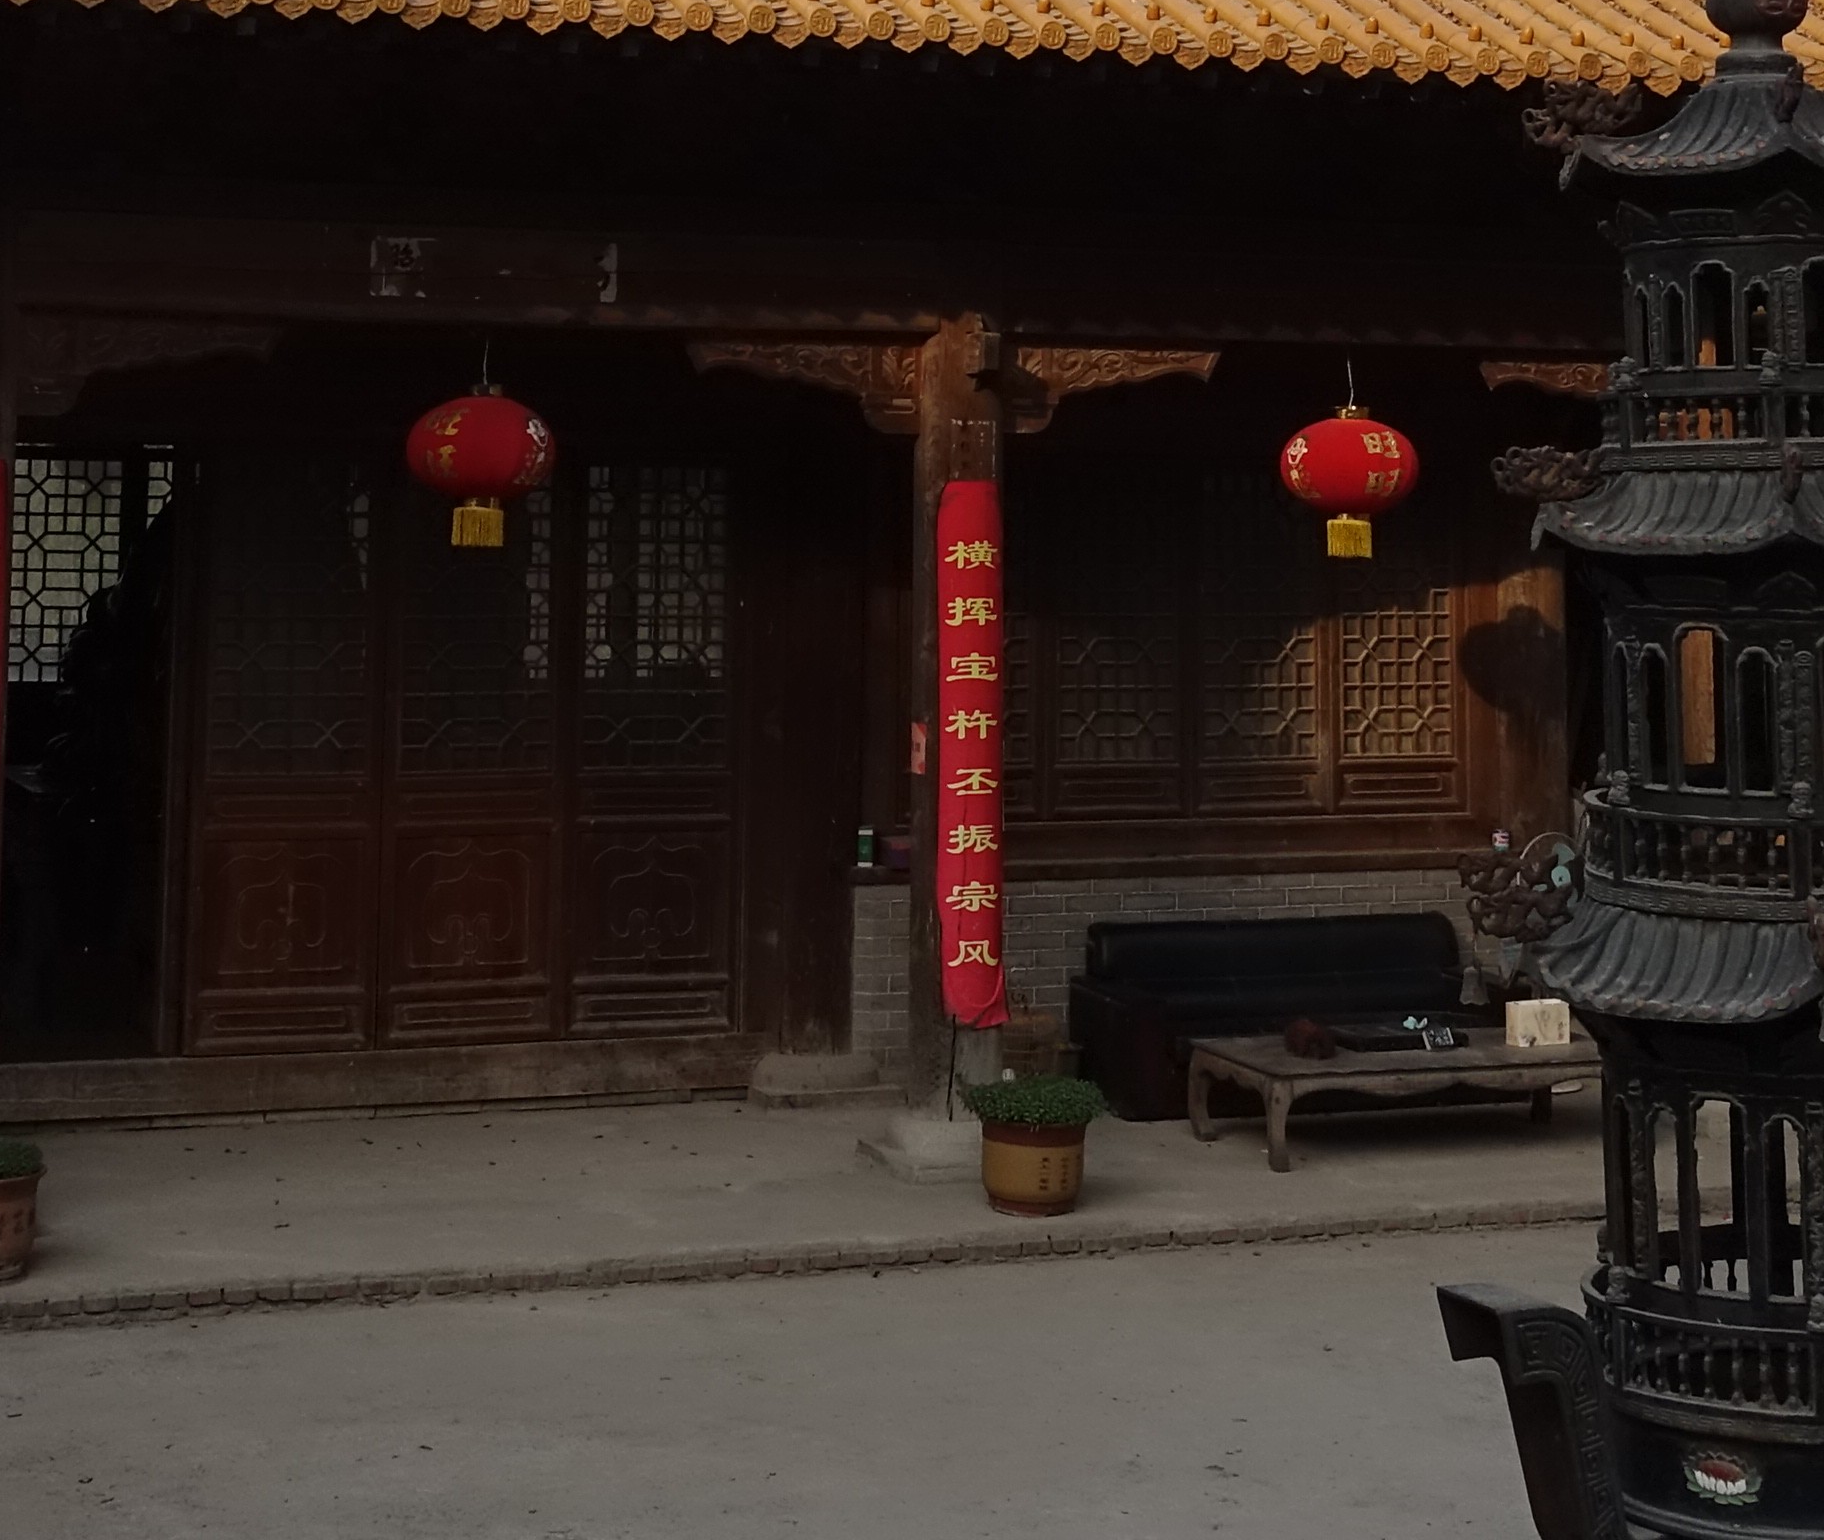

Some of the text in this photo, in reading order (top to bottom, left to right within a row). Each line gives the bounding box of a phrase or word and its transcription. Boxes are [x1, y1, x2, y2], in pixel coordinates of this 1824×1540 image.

[944, 540, 999, 967] 横挥宝杵丕振宗风
